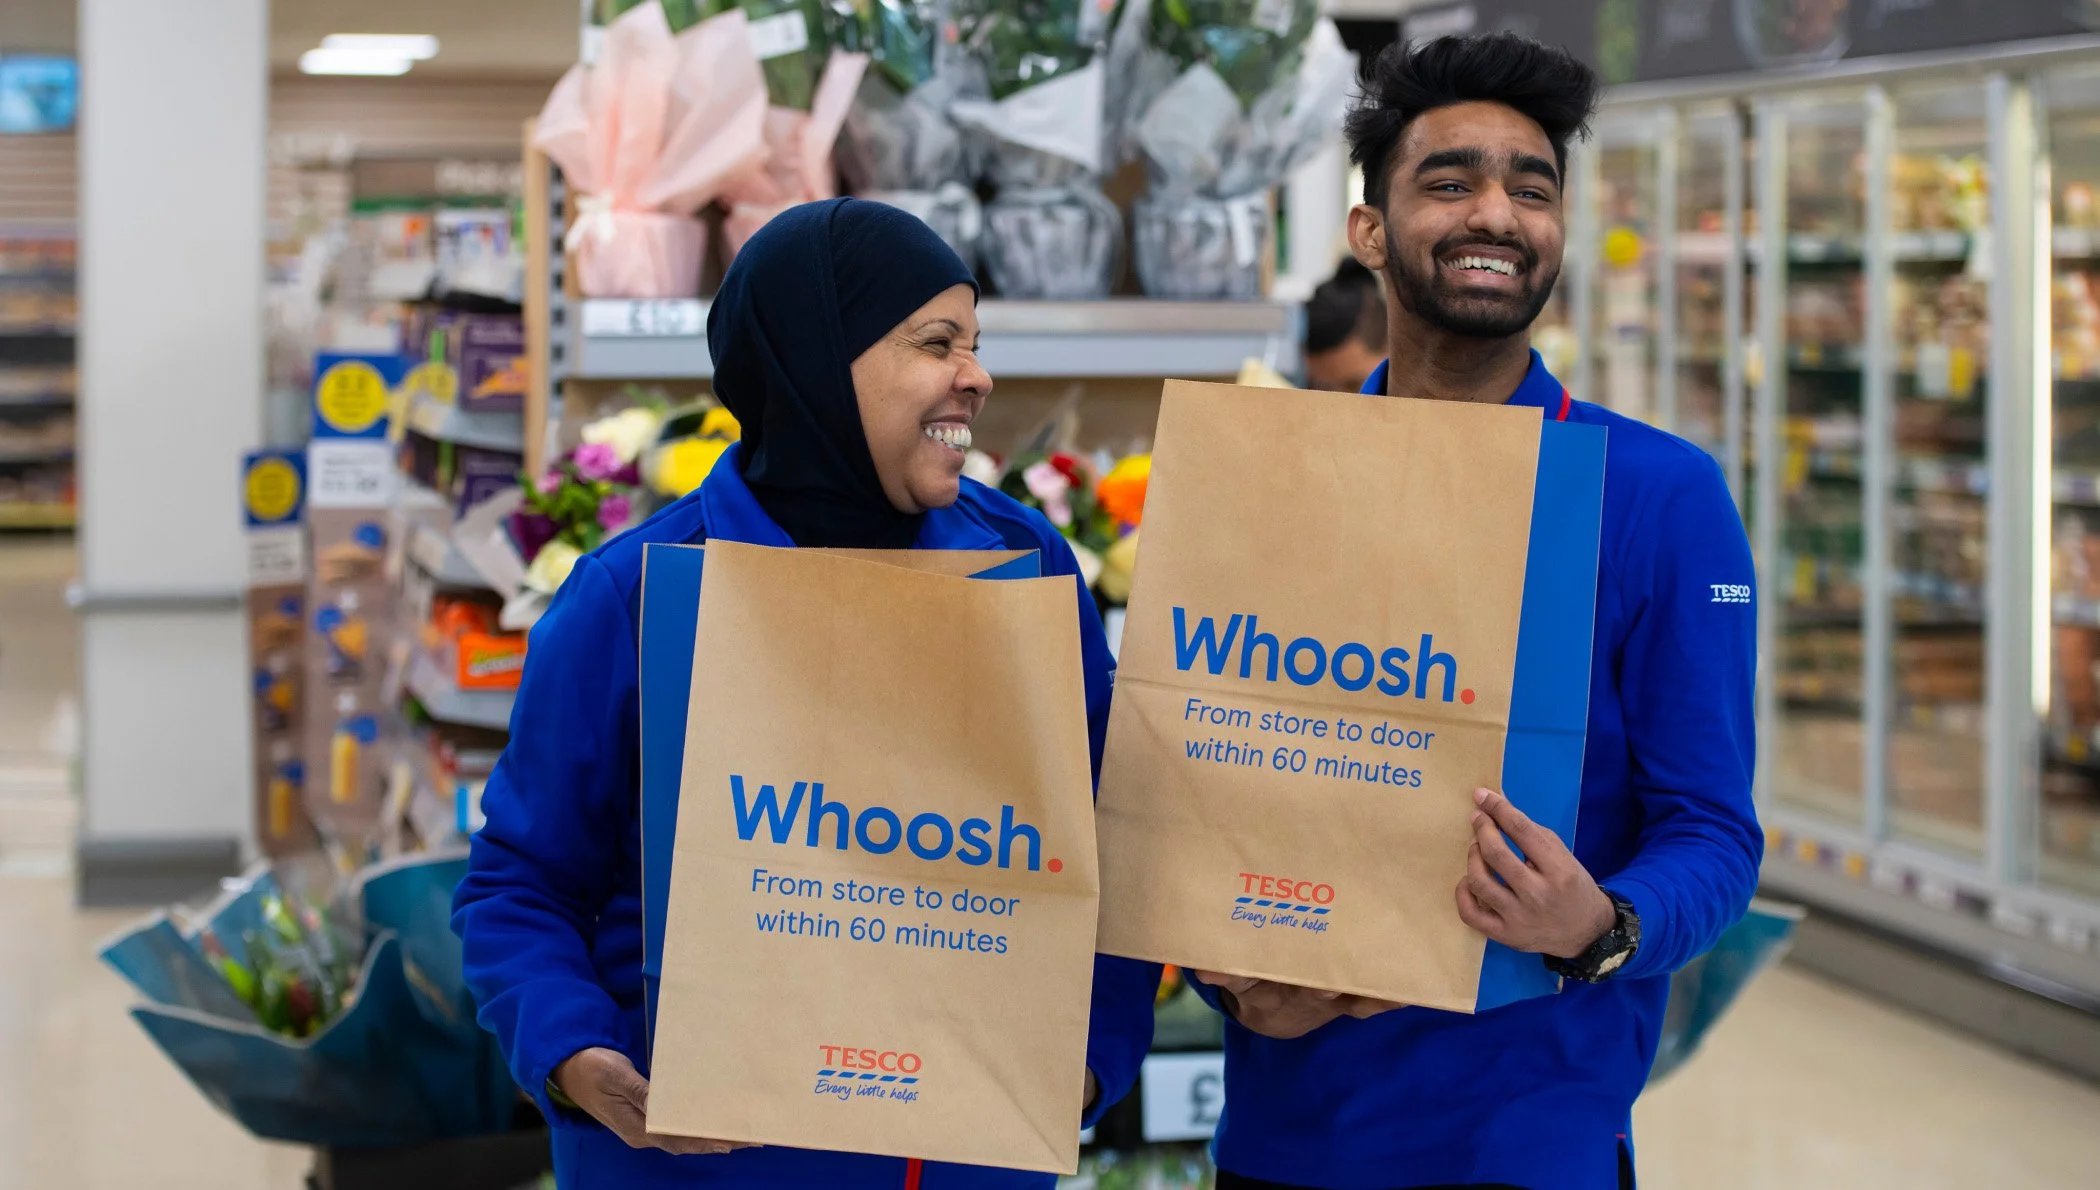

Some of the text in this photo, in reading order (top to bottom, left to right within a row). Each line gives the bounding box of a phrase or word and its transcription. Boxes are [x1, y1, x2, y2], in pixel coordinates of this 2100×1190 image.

[1710, 584, 1751, 598] TESCO
[1172, 606, 1476, 705] Whoosh.
[1185, 697, 1436, 750] From store to door
[1185, 737, 1422, 789] within 60 minutes
[728, 774, 1064, 874] Whoosh.
[751, 867, 1021, 917] From store to door
[1239, 872, 1336, 905] TESCO
[755, 908, 1009, 955] within 60 minutes
[1231, 905, 1329, 934] Every little helps
[819, 1045, 923, 1074] TESCO
[814, 1079, 919, 1104] Every little helps
